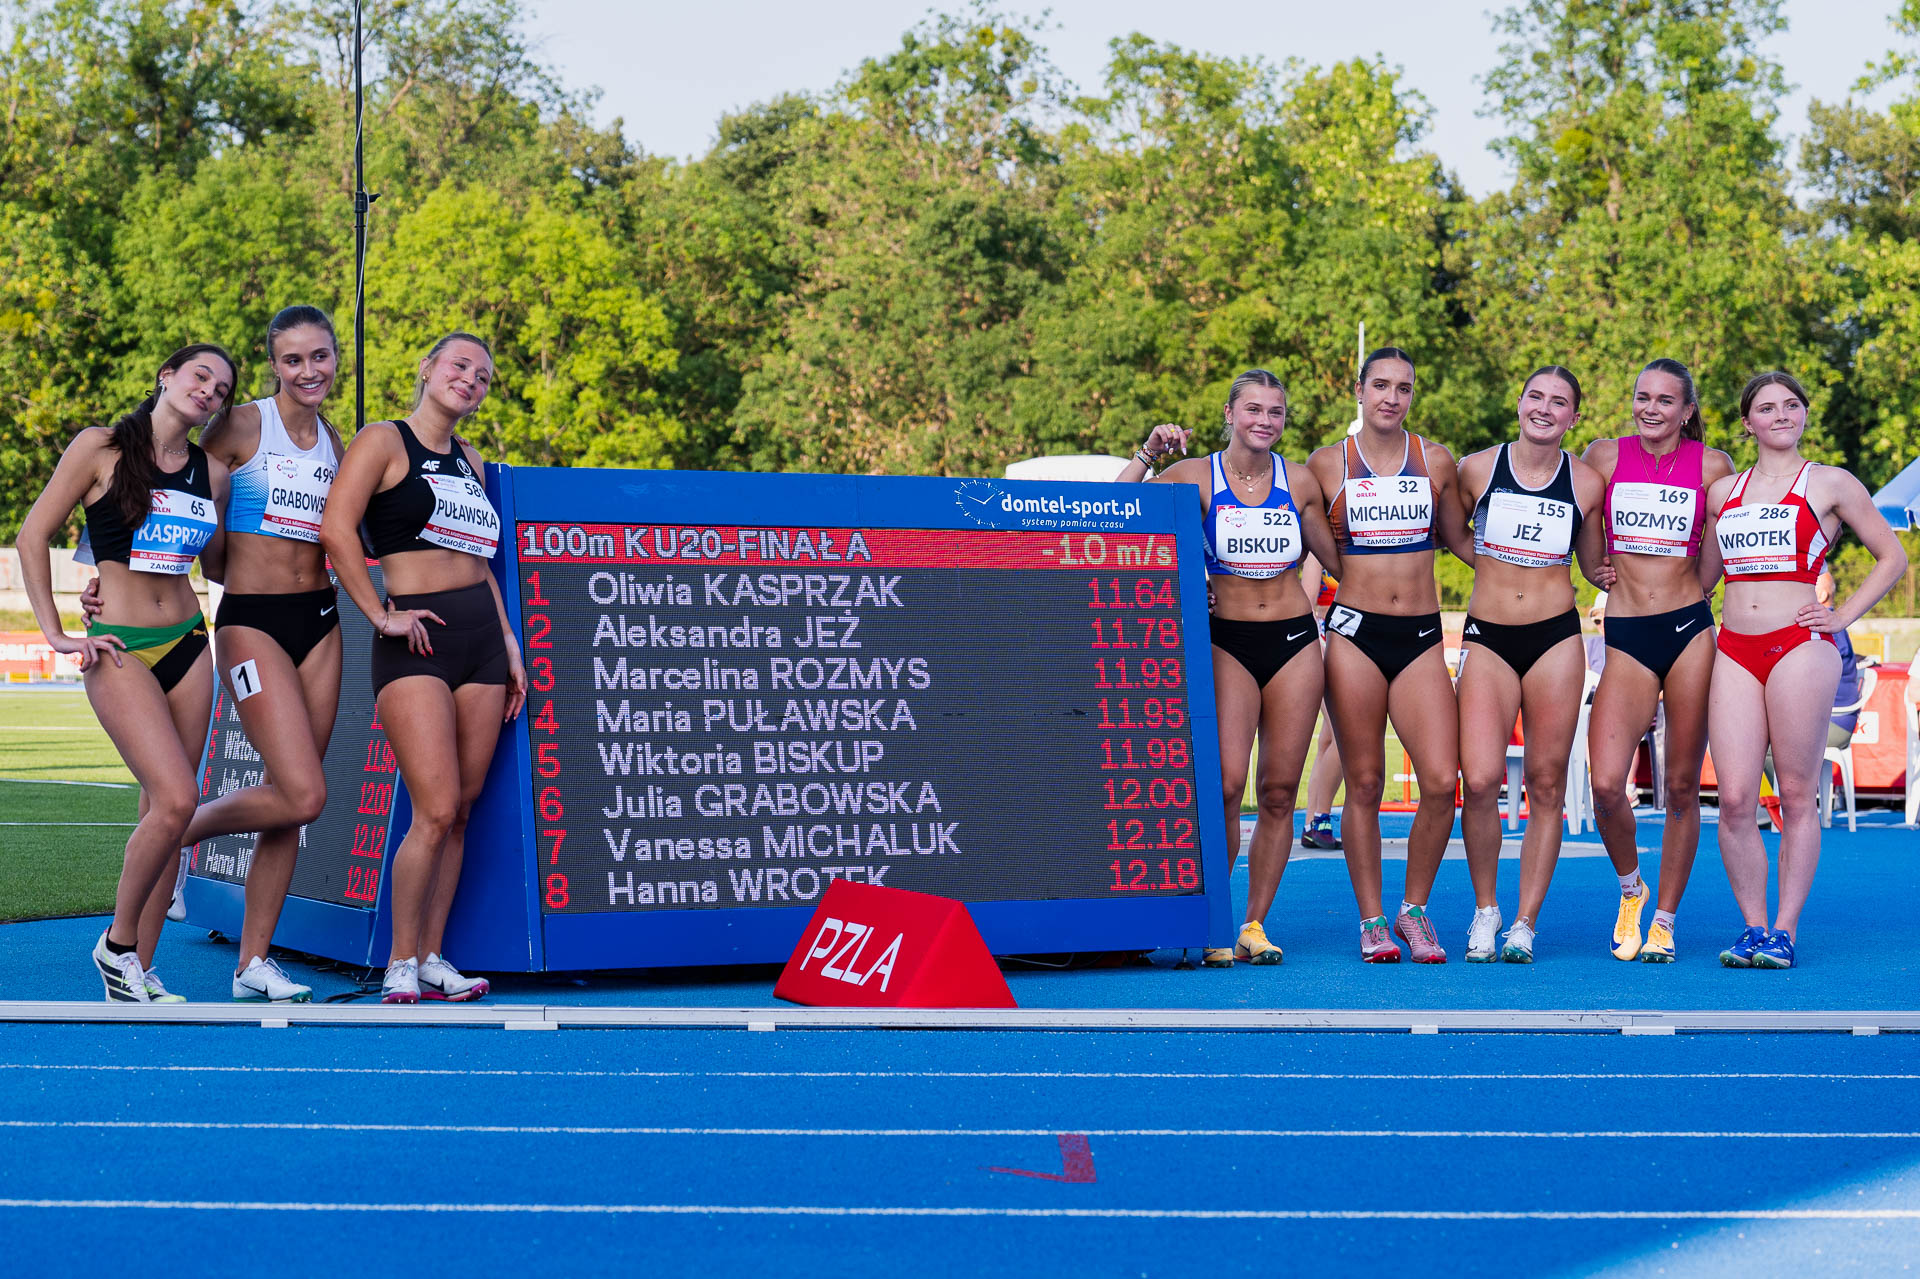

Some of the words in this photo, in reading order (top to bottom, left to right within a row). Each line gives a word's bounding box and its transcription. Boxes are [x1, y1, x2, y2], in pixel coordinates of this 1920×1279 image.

[421, 460, 440, 472] 4F
[1398, 480, 1418, 493] 32
[1659, 488, 1689, 504] 169
[147, 506, 171, 514] RLEN
[191, 500, 205, 517] 65
[272, 487, 327, 514] GRABOWS
[1001, 494, 1142, 519] domtel-sport.pl
[1537, 502, 1566, 518] 155
[436, 498, 498, 530] PUŁAWSKA
[1021, 517, 1058, 528] systemy
[1060, 518, 1097, 529] pomiaru
[1100, 521, 1125, 529] czasu
[1263, 512, 1292, 526] 522
[1350, 504, 1429, 522] MICHALUK
[1615, 510, 1688, 532] ROZMYS
[1759, 507, 1790, 520] 286
[137, 523, 211, 548] KASPRZAK
[280, 527, 309, 538] ZAMOŚĆ
[437, 537, 466, 549] ZAMOŚĆ
[1512, 523, 1543, 542] JEŻ
[1720, 529, 1791, 549] WROTEK
[522, 526, 615, 558] 100m
[1042, 534, 1107, 565] -1.0
[1116, 535, 1172, 566] m/s
[1227, 538, 1290, 553] BISKUP
[1624, 543, 1653, 552] ZAMOŚĆ
[1498, 552, 1530, 564] ZAMOŚĆ
[1735, 564, 1759, 572] ZAMOŚĆ
[1233, 569, 1264, 577] ZAMOŚĆ
[527, 571, 550, 606] 1
[588, 572, 692, 606] Oliwia
[704, 573, 904, 607] KASPRZAK
[1088, 578, 1176, 609] 11.64
[527, 614, 553, 649] 2
[592, 614, 782, 648] Aleksandra
[793, 610, 862, 648] JEŻ
[1091, 617, 1180, 649] 11.78
[1336, 609, 1356, 630] 7
[237, 665, 252, 695] 1
[531, 656, 555, 691] 3
[593, 657, 759, 690] Marcelina
[771, 657, 931, 690] ROZMYS
[1094, 657, 1181, 689] 11.93
[533, 700, 560, 735] 4
[596, 700, 691, 733] Maria
[703, 699, 917, 732] PUŁAWSKA
[1097, 698, 1185, 729] 11.95
[208, 729, 219, 759] 5
[537, 743, 561, 778] 5
[598, 743, 742, 776] Wiktoria
[754, 740, 885, 774] BISKUP
[1100, 738, 1189, 769] 11.98
[202, 766, 212, 796] 6
[538, 786, 564, 821] 6
[601, 785, 682, 819] Julia
[694, 781, 942, 818] GRABOWSKA
[1103, 778, 1192, 810] 12.00
[542, 829, 568, 865] 7
[603, 827, 751, 862] Vanessa
[762, 822, 962, 859] MICHALUK
[1107, 818, 1194, 850] 12.12
[205, 842, 235, 876] Hanna
[546, 873, 570, 909] 8
[607, 871, 718, 905] Hanna
[1109, 858, 1199, 891] 12.18
[799, 917, 904, 993] PZLA
